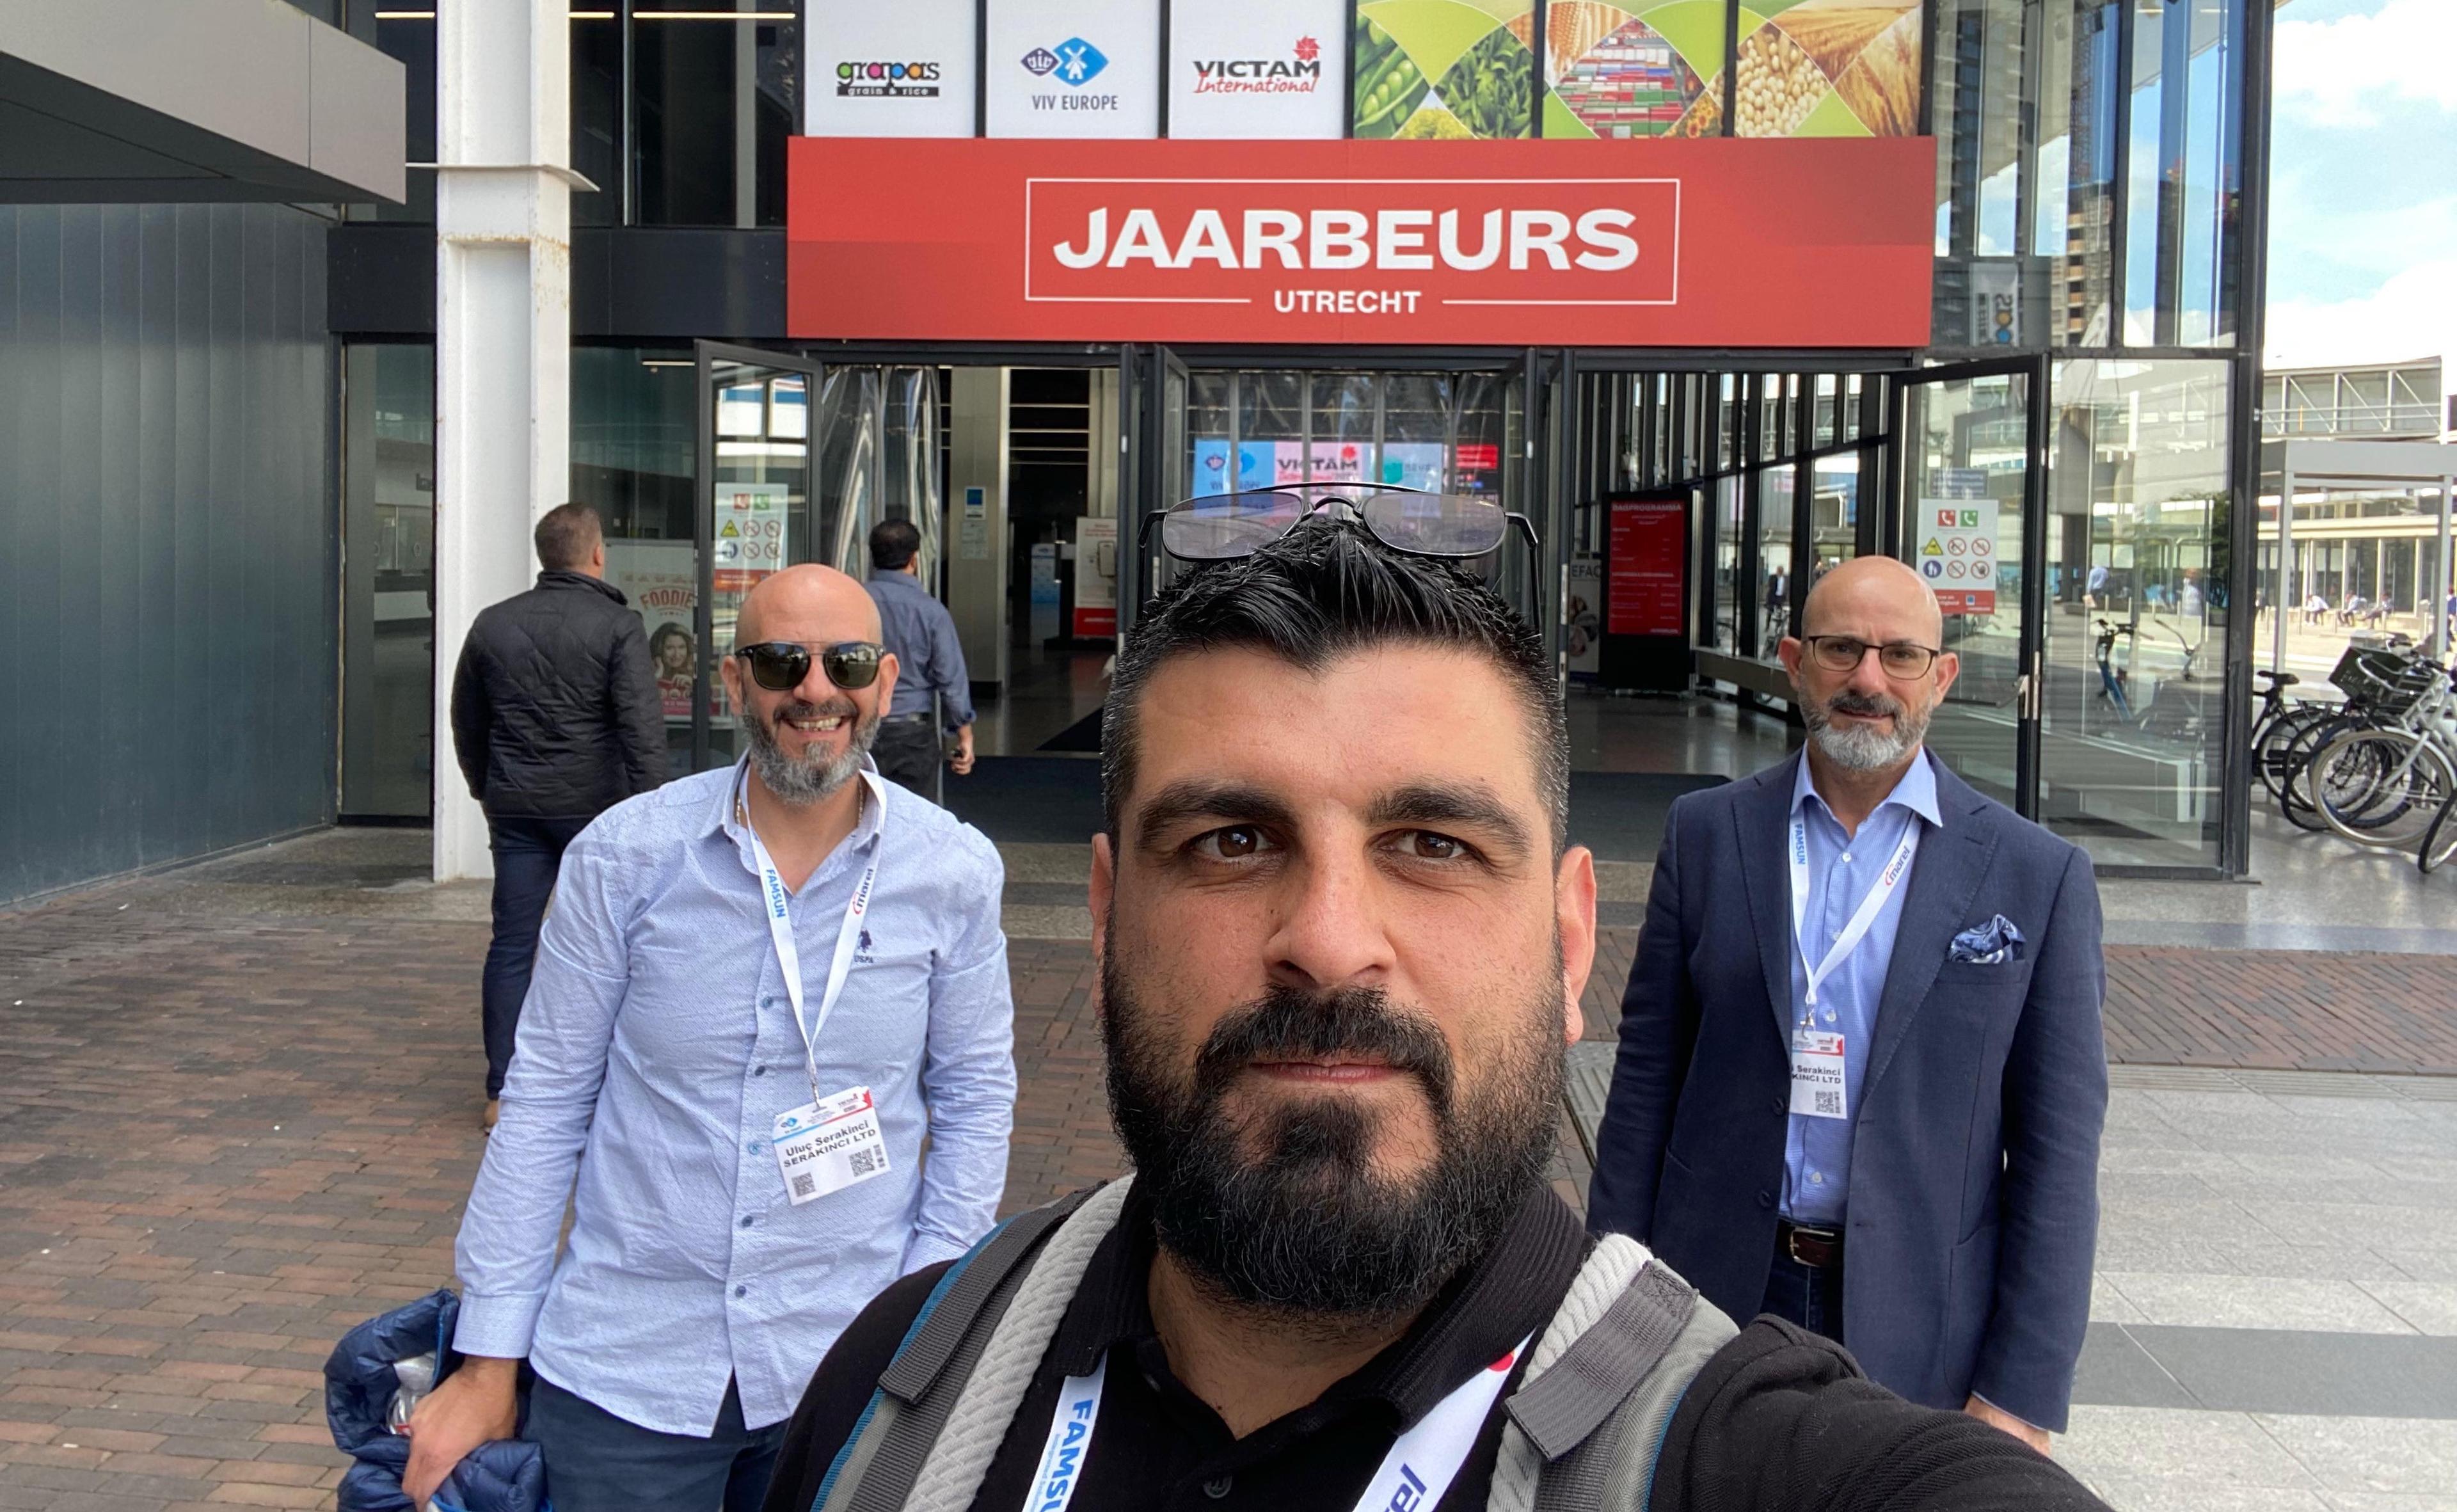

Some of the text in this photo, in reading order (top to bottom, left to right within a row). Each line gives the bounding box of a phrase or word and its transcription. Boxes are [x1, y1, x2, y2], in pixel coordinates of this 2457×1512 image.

[837, 62, 939, 87] grapas
[1193, 61, 1320, 77] VICTAM
[848, 87, 928, 96] grain & rice
[1193, 71, 1319, 93] International
[1032, 95, 1118, 110] VIV EUROPE
[1053, 207, 1639, 271] JAARBEURS
[1274, 290, 1421, 314] UTRECHT
[1277, 459, 1357, 471] VITAM
[1794, 824, 1806, 864] FAMSUN
[1889, 845, 1910, 882] marel
[766, 869, 786, 918] FAMSUN
[856, 868, 874, 907] marel
[1797, 1064, 1841, 1076] Serakinci
[1822, 1076, 1841, 1084] LTD
[784, 1129, 876, 1168] SERAKINCI LTD
[785, 1120, 869, 1157] Uluç Serakinci
